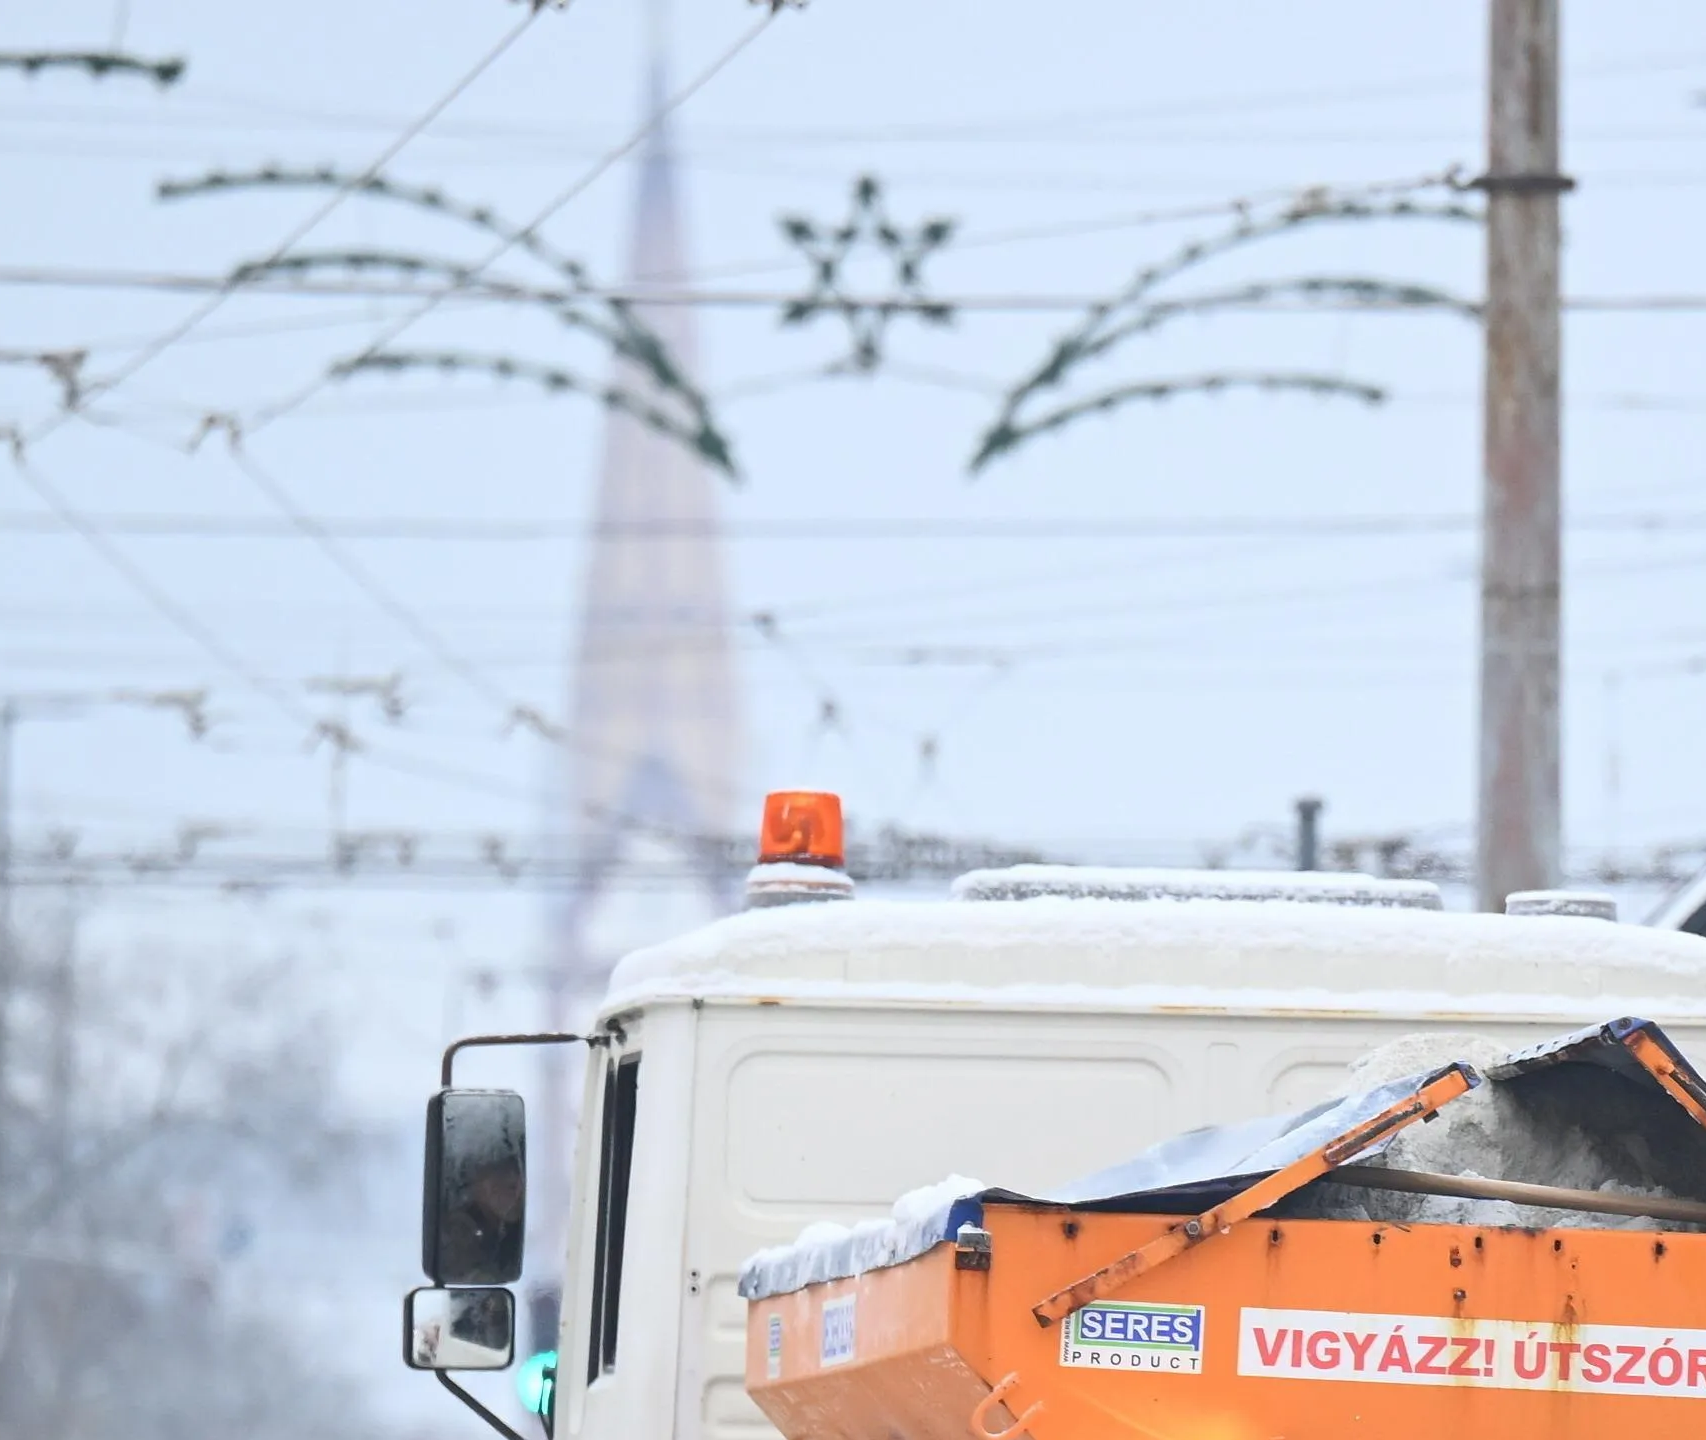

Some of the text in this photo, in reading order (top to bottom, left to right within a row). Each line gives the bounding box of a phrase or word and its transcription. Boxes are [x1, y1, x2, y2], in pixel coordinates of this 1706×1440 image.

[1081, 1311, 1194, 1343] SERES
[1071, 1351, 1200, 1370] PRODUCT
[1252, 1324, 1494, 1377] VIGYÁZZ!
